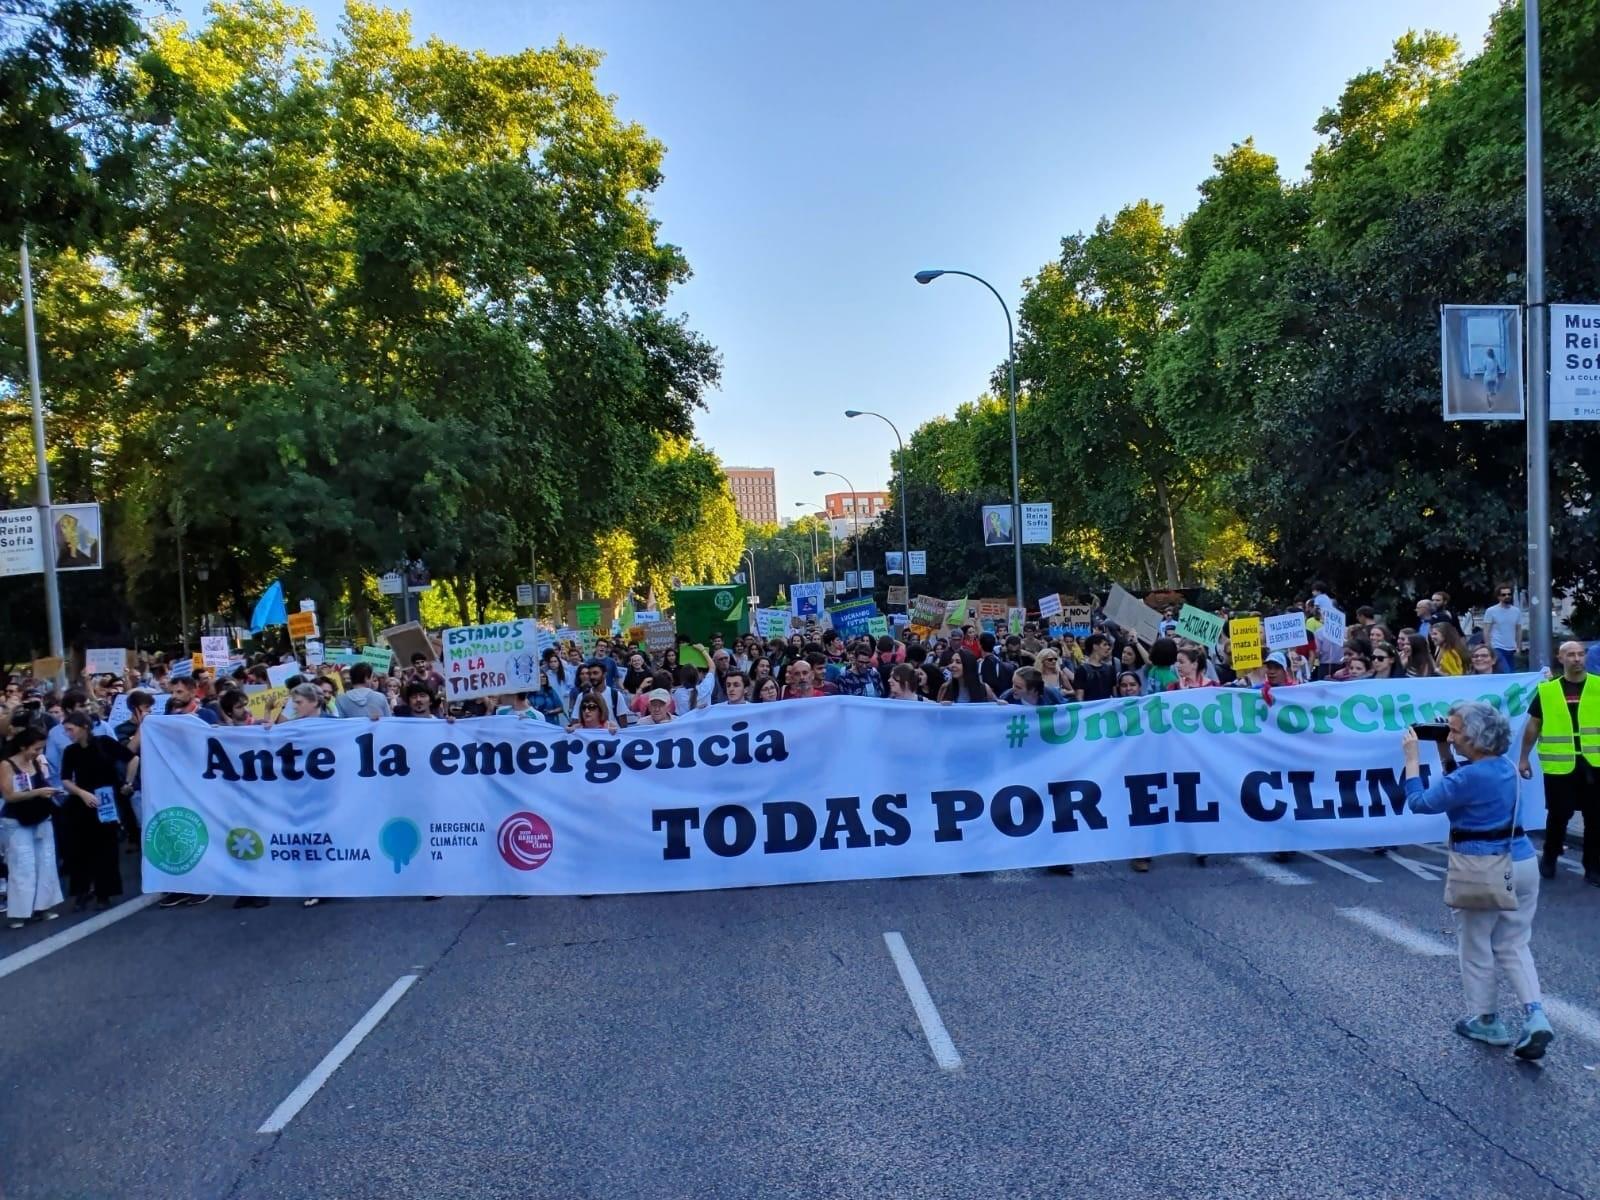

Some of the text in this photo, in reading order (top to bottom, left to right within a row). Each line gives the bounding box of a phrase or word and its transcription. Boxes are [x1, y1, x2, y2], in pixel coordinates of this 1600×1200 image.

[0, 514, 33, 524] Museo
[0, 525, 33, 536] Reina
[0, 537, 34, 547] Sofía
[1070, 608, 1090, 616] NOW
[448, 621, 524, 645] ESTAMOS
[1233, 638, 1259, 649] mata al
[449, 640, 525, 660] MATANDO
[453, 657, 485, 672] A LA
[448, 672, 506, 694] TIERRA
[202, 721, 790, 784] Ante la emergencia
[651, 763, 1472, 860] TODAS POR EL CLIM
[430, 823, 486, 833] EMERGENCIA
[270, 832, 332, 846] ALIANZA
[430, 836, 478, 847] CLIMÁTICA
[271, 848, 371, 862] POR EL CLIMA
[431, 850, 443, 861] YA
